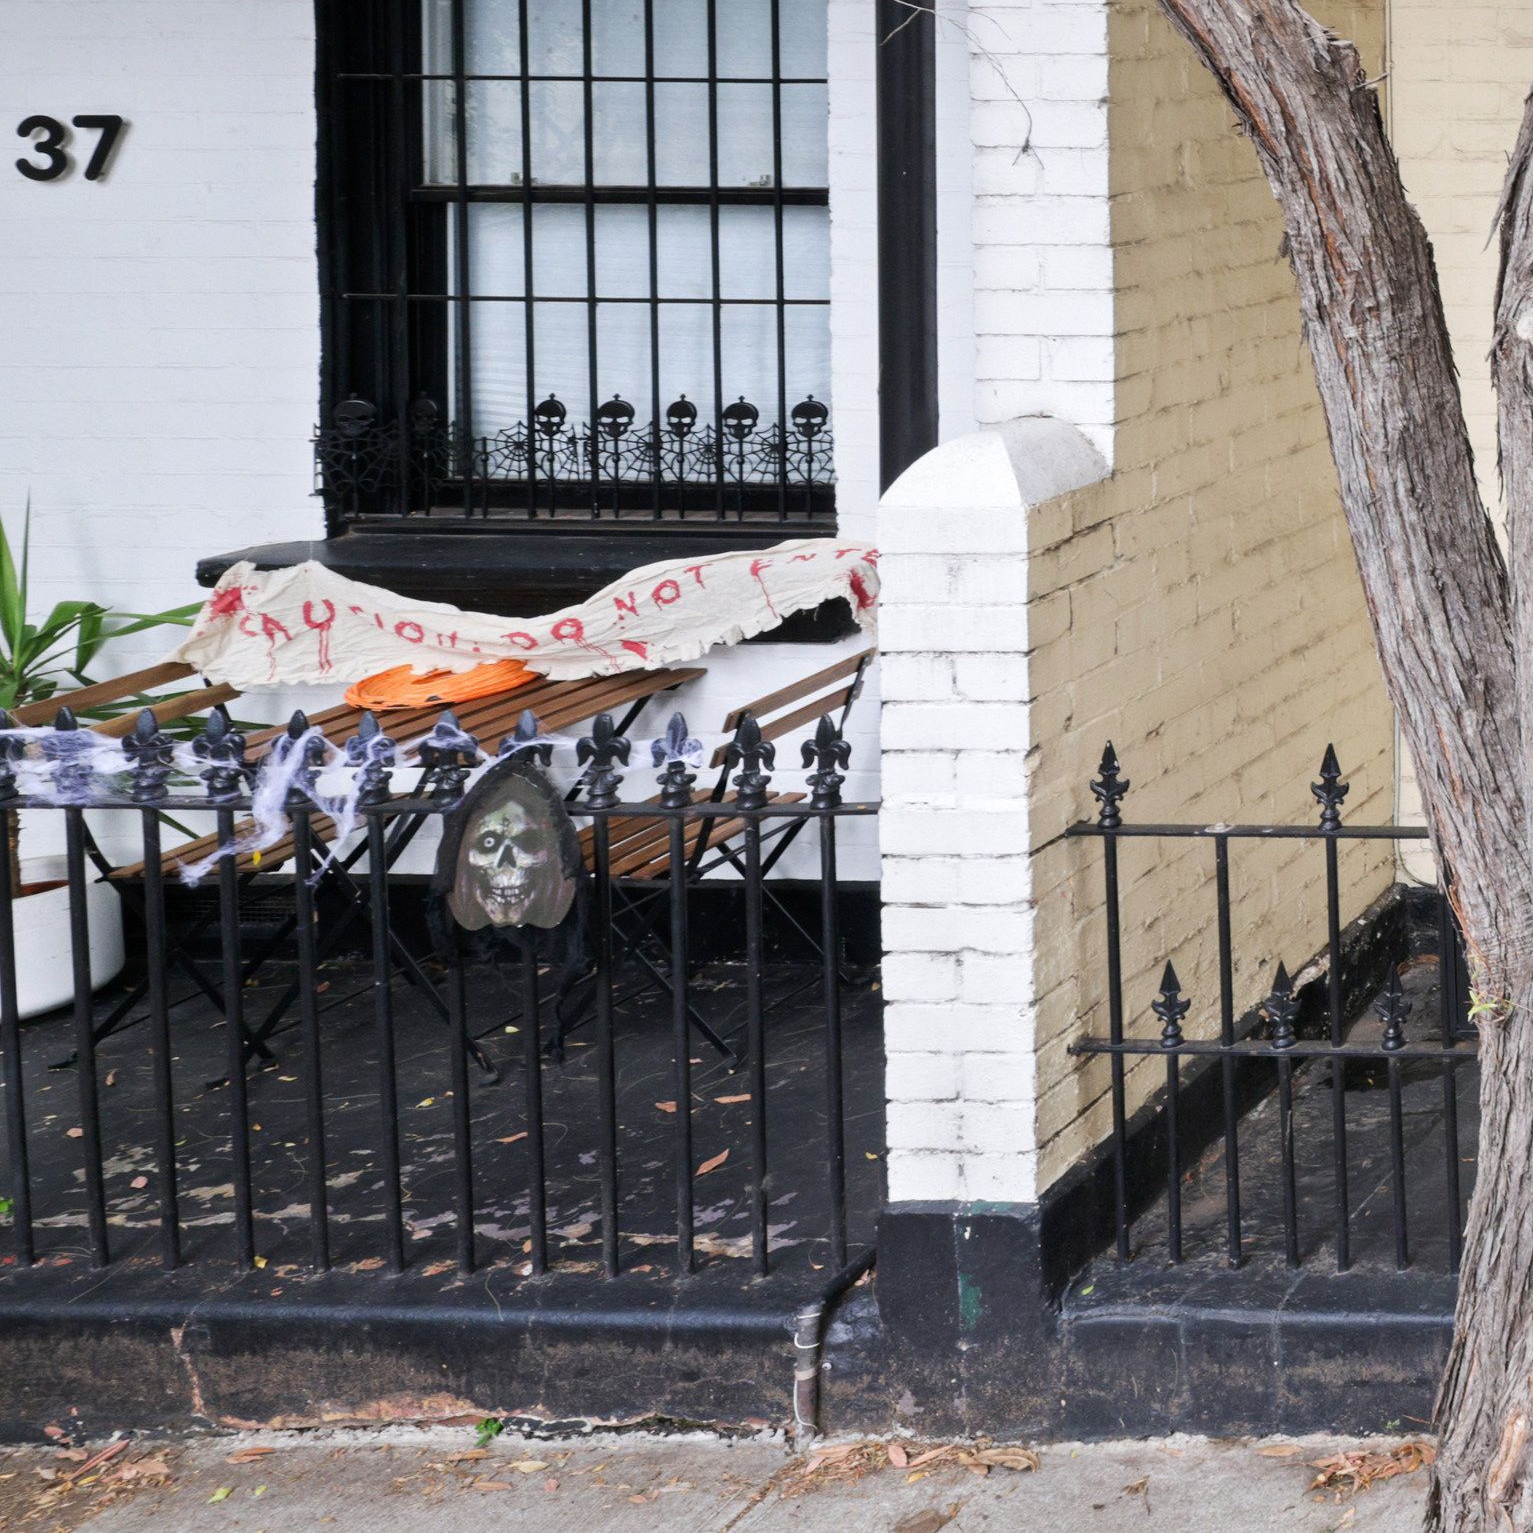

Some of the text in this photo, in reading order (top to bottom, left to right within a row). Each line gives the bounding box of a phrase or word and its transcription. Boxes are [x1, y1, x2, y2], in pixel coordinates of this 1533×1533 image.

[15, 114, 123, 181] 37
[500, 617, 584, 650] DO
[613, 563, 713, 617] NOT
